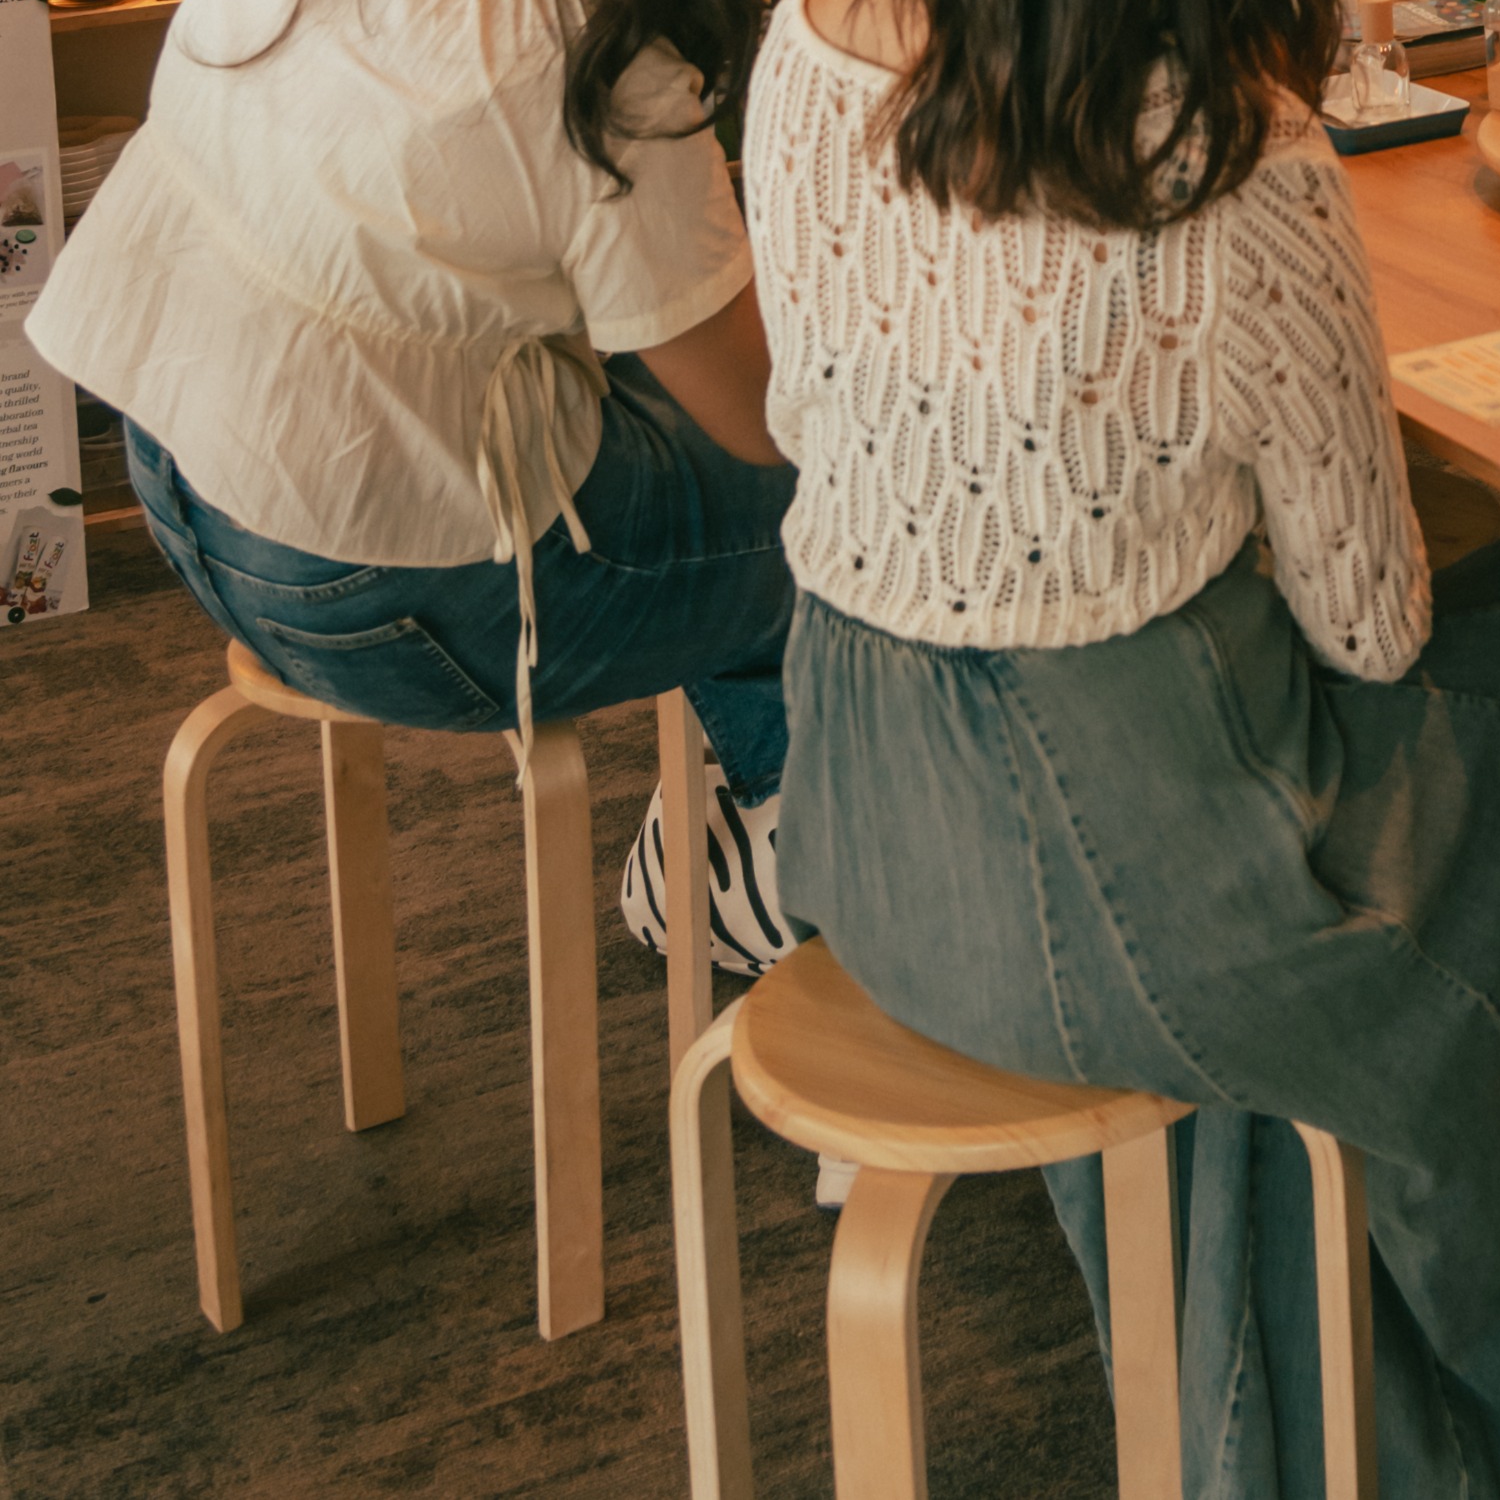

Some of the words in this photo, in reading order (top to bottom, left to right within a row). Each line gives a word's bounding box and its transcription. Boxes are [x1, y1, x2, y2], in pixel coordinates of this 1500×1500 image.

[1, 369, 30, 381] brand
[4, 384, 41, 396] quality.
[4, 394, 40, 408] thrilled
[25, 422, 38, 431] tea
[17, 446, 43, 460] world
[8, 460, 48, 473] flavours
[14, 488, 37, 501] their
